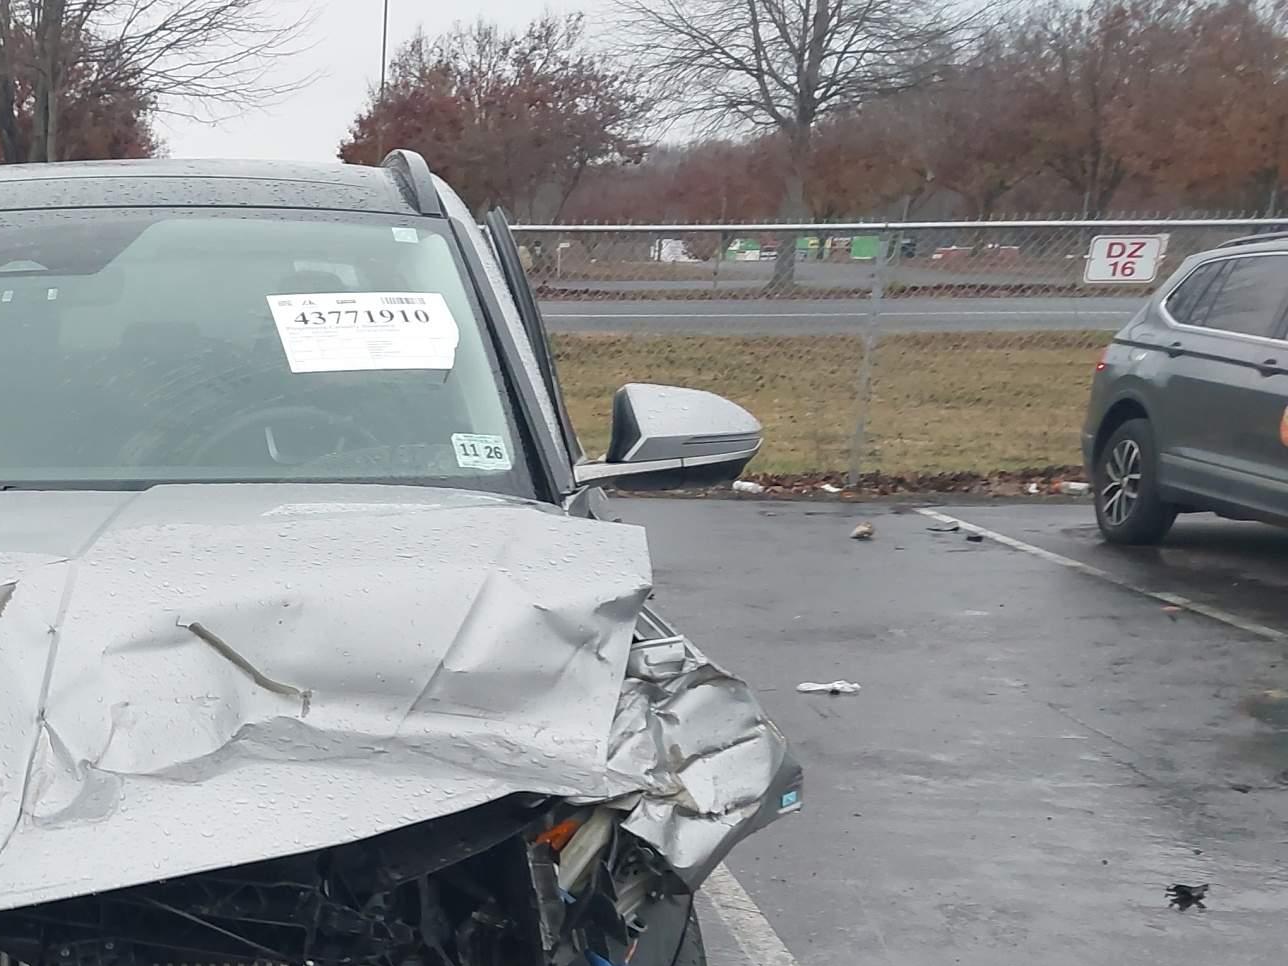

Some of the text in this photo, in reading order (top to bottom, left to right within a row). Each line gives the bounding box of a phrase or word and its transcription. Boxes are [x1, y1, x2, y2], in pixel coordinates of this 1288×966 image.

[1106, 242, 1146, 258] DZ
[1108, 261, 1136, 277] 16
[294, 309, 430, 325] 43771910
[460, 443, 503, 459] 11 26
